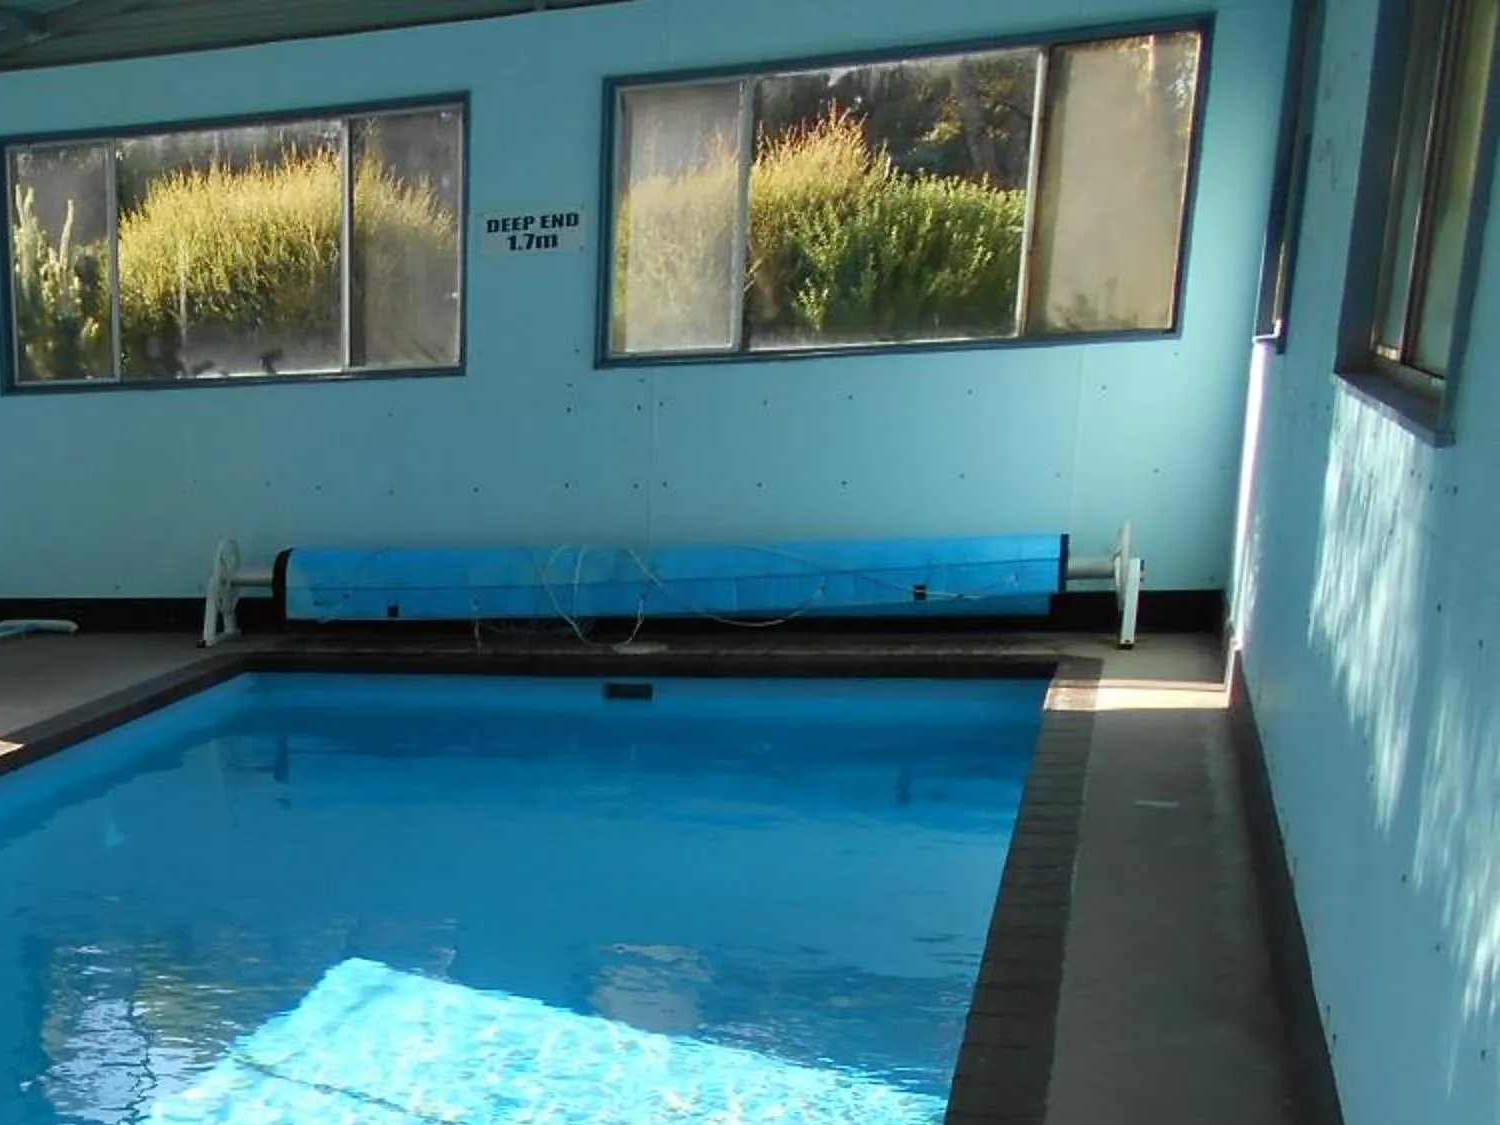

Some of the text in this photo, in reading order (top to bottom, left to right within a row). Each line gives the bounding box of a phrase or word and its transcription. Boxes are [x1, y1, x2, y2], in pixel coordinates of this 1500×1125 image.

[486, 212, 579, 233] DEEP END
[507, 233, 558, 251] 1.7m
